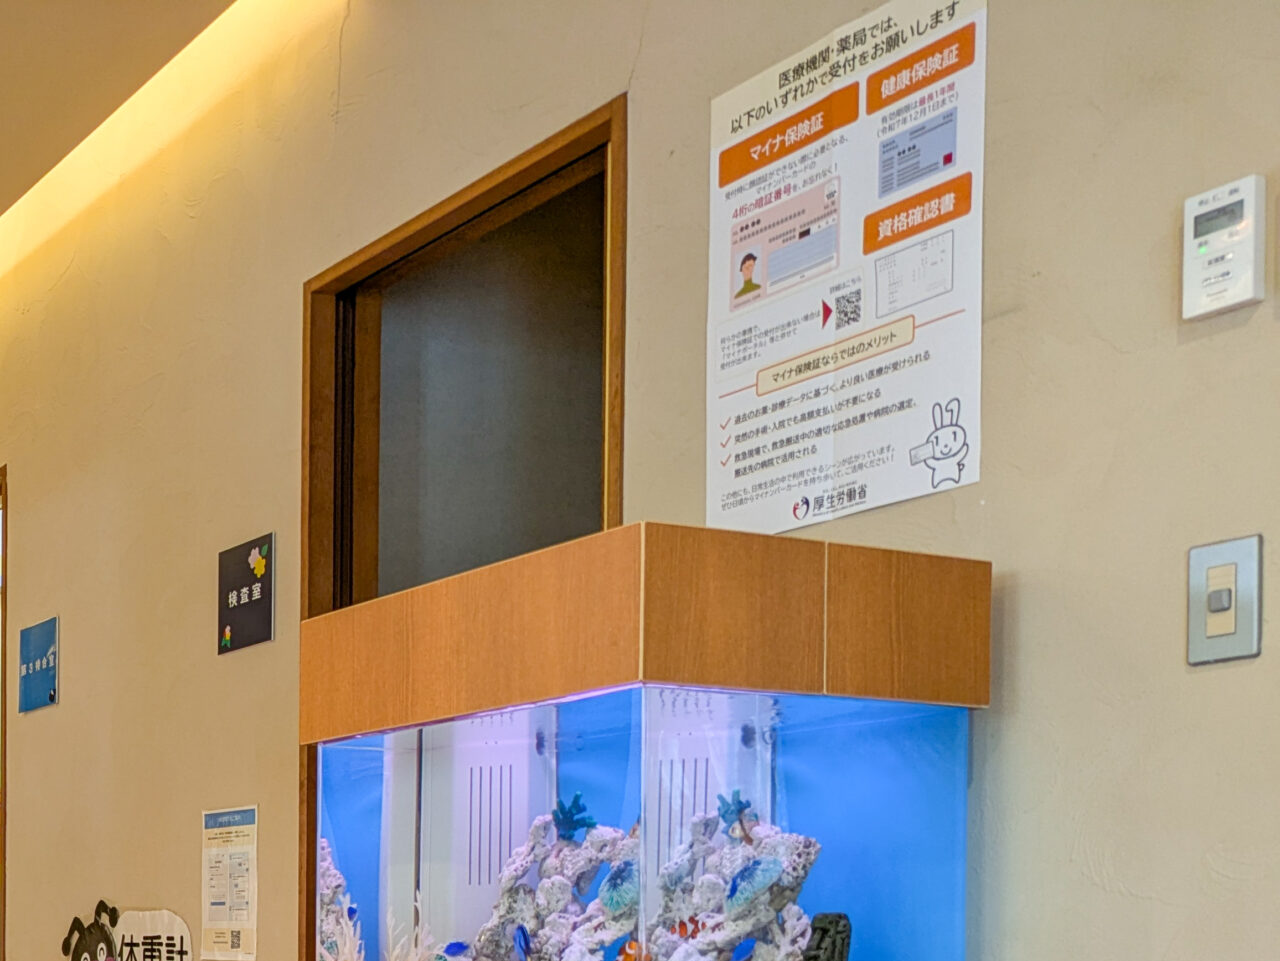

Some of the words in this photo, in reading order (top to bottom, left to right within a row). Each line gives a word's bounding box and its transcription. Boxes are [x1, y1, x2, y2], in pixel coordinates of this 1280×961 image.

[730, 1, 960, 135] 以下のいずれかで受付をお願いします
[778, 15, 899, 89] 医療機関・薬局では、
[881, 44, 959, 99] 健康保険証
[749, 112, 824, 161] マイナ保険証
[878, 192, 956, 241] 資格確認書
[772, 331, 898, 384] マイナ保険証ならではのメリット
[812, 484, 868, 512] 厚生労働省
[228, 581, 262, 609] 検査室
